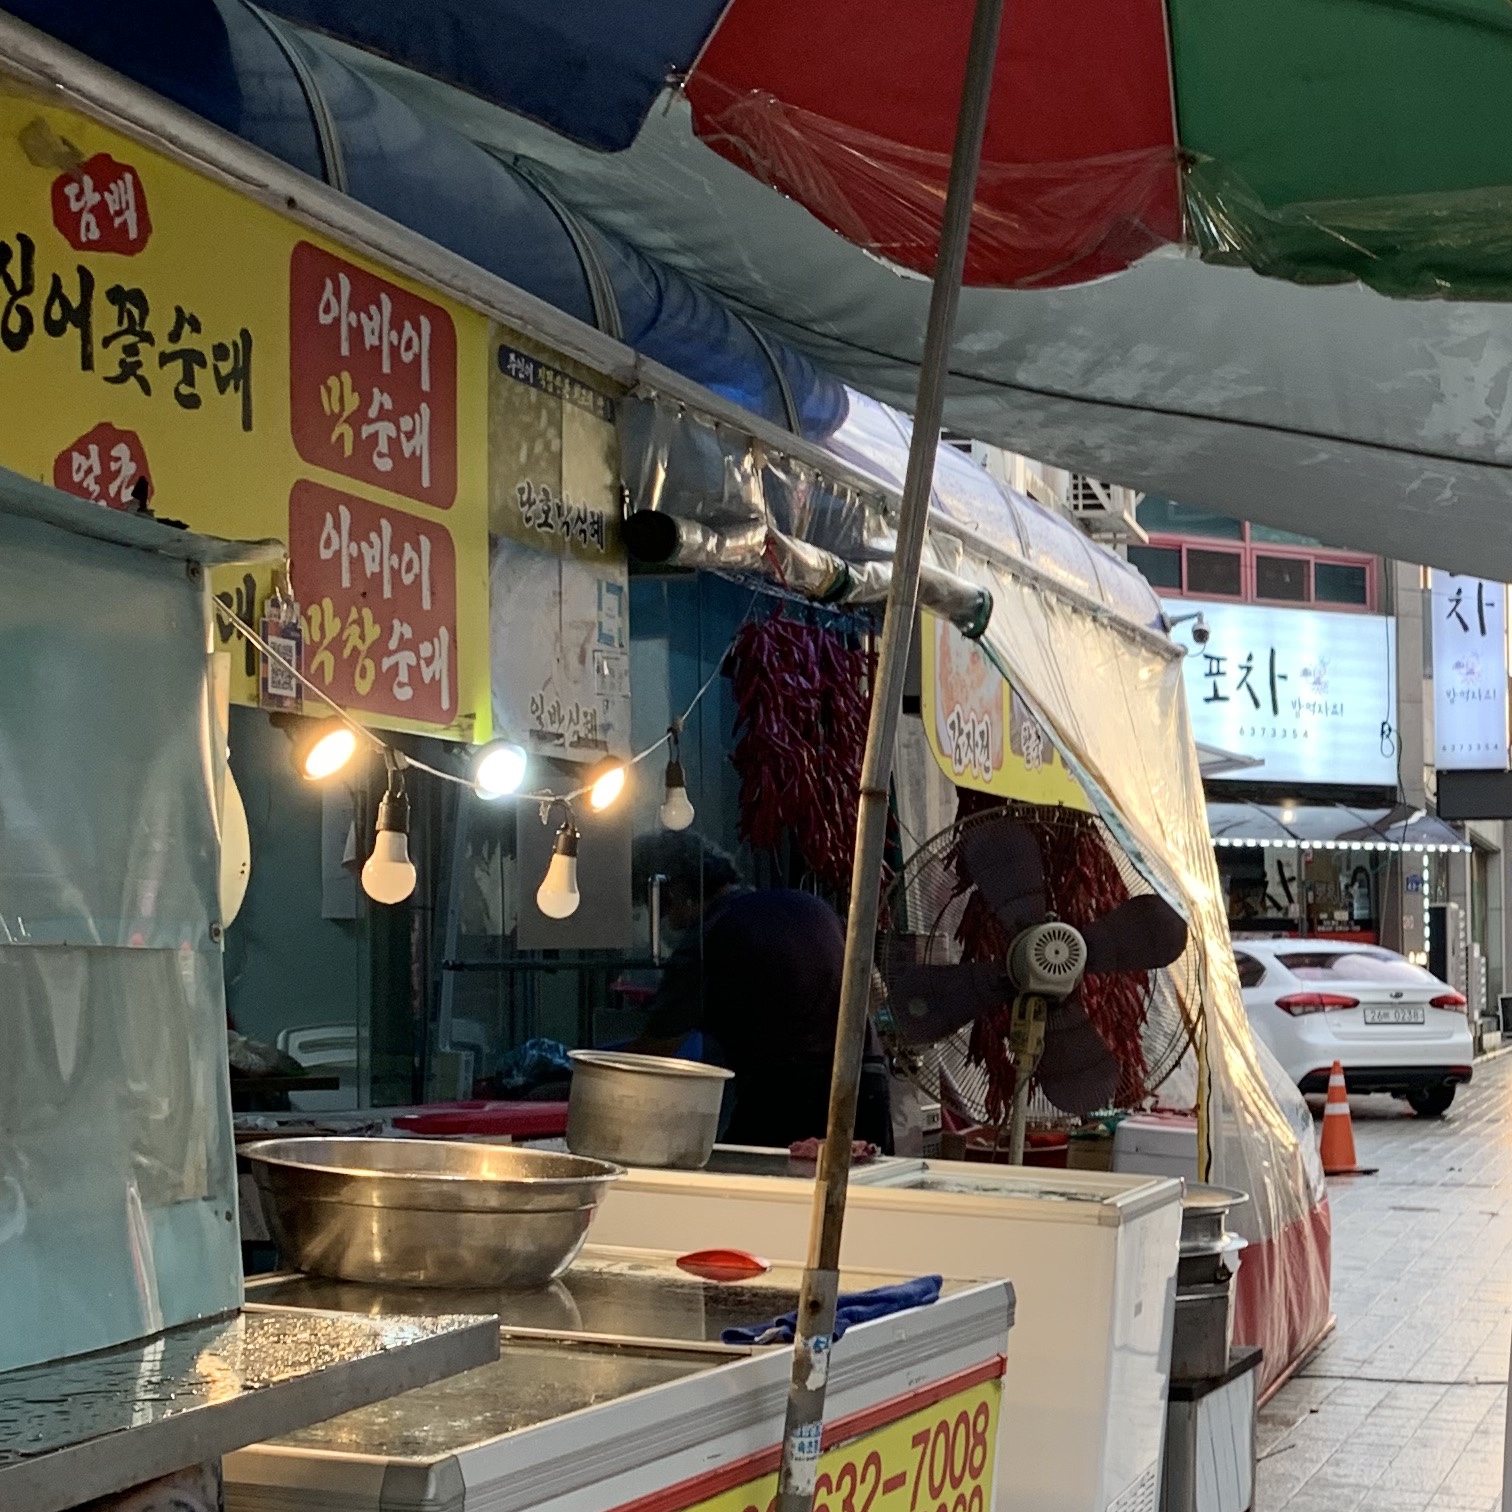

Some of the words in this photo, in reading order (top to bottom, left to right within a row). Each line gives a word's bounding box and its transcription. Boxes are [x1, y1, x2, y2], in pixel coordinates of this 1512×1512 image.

[63, 171, 138, 243] 담백
[318, 272, 431, 392] 아바이
[320, 370, 430, 488] 막순대
[516, 479, 605, 552] 단호박식혜
[318, 504, 432, 610] 아바이
[1202, 646, 1289, 717] 포차
[1239, 725, 1309, 740] 6373354
